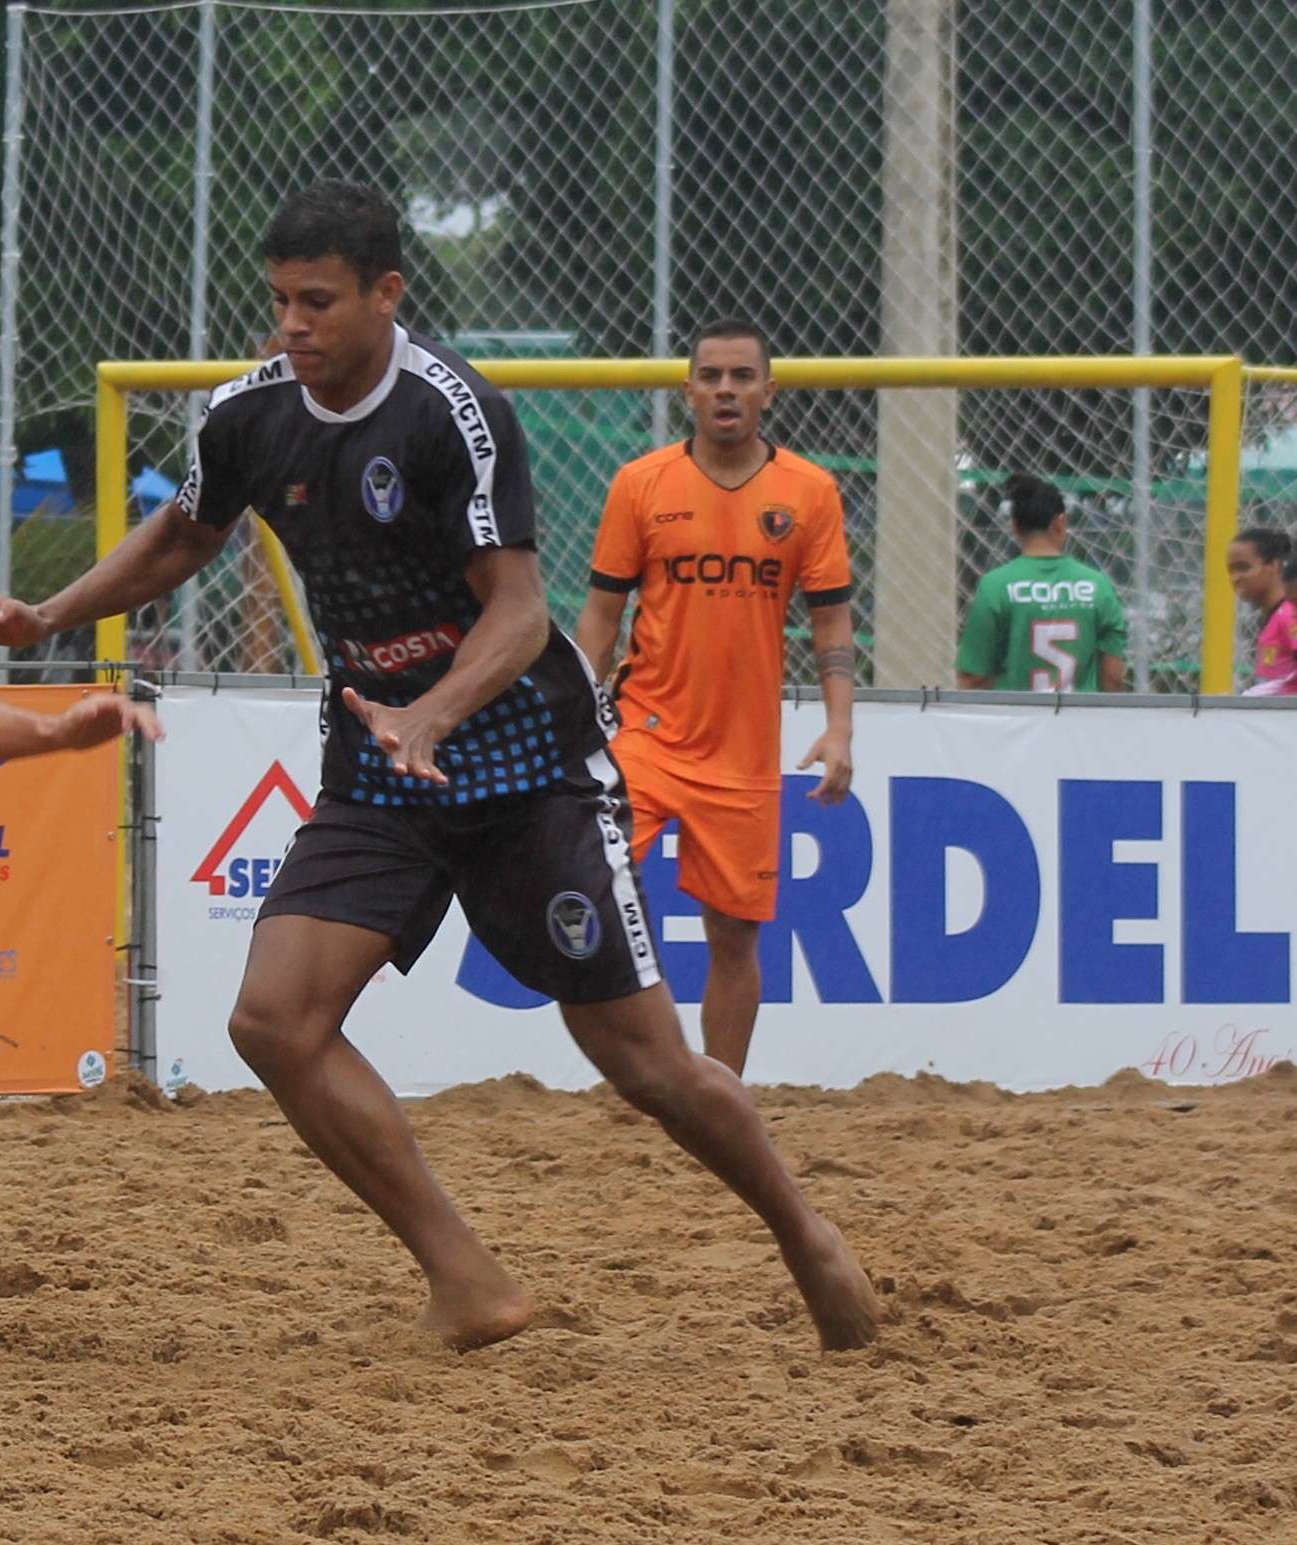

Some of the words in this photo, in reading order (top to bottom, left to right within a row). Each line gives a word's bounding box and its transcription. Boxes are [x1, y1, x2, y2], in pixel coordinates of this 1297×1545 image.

[1032, 621, 1078, 692] 5
[208, 907, 256, 922] SERVIÇOS
[623, 902, 647, 957] CTM
[1140, 1031, 1197, 1077] 40
[1204, 1023, 1292, 1078] Ano
